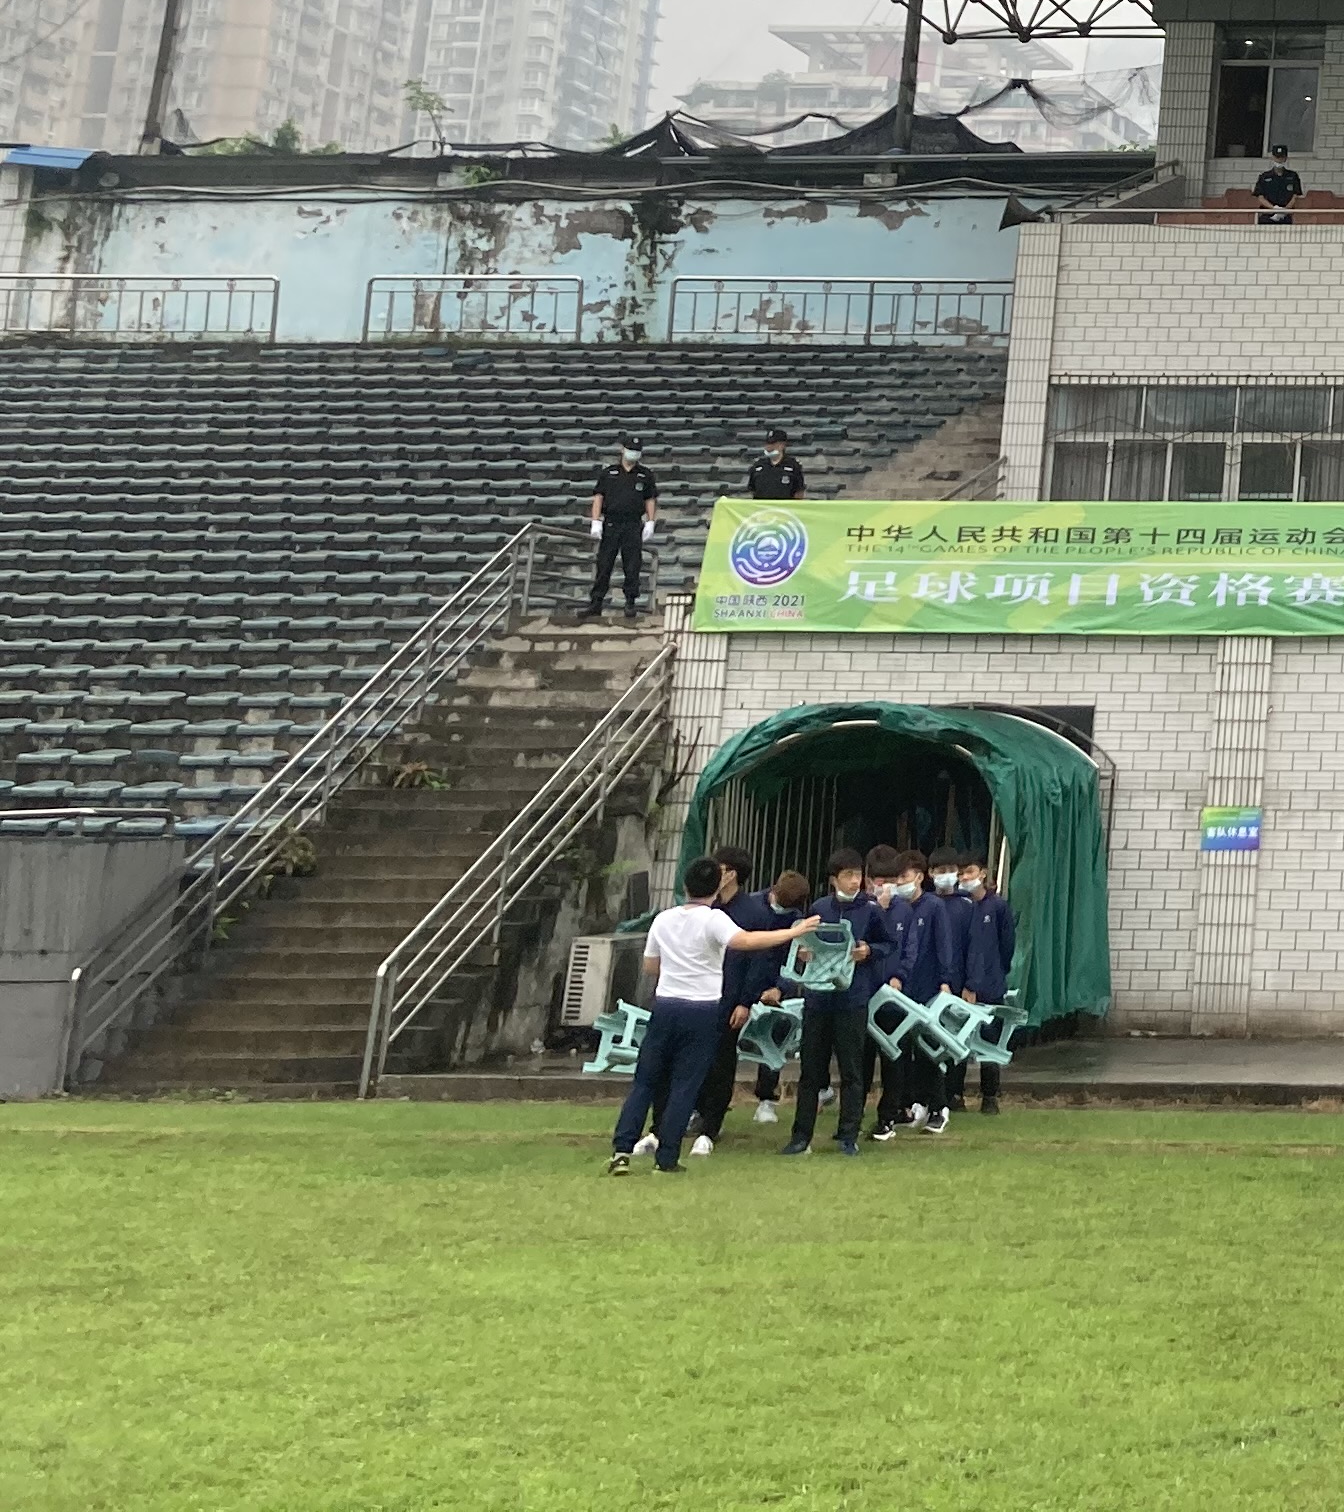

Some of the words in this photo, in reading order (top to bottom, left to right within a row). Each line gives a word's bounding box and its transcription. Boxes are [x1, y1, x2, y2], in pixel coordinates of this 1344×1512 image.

[847, 543, 881, 553] THE
[919, 544, 988, 554] GAMES
[993, 545, 1020, 554] OF
[1023, 545, 1060, 555] THE
[1065, 545, 1156, 556] PEOPLE'S
[1161, 546, 1258, 556] REPUBLIC
[1261, 546, 1284, 556] OF
[772, 594, 805, 606] 2021
[714, 608, 767, 618] SHAANXI
